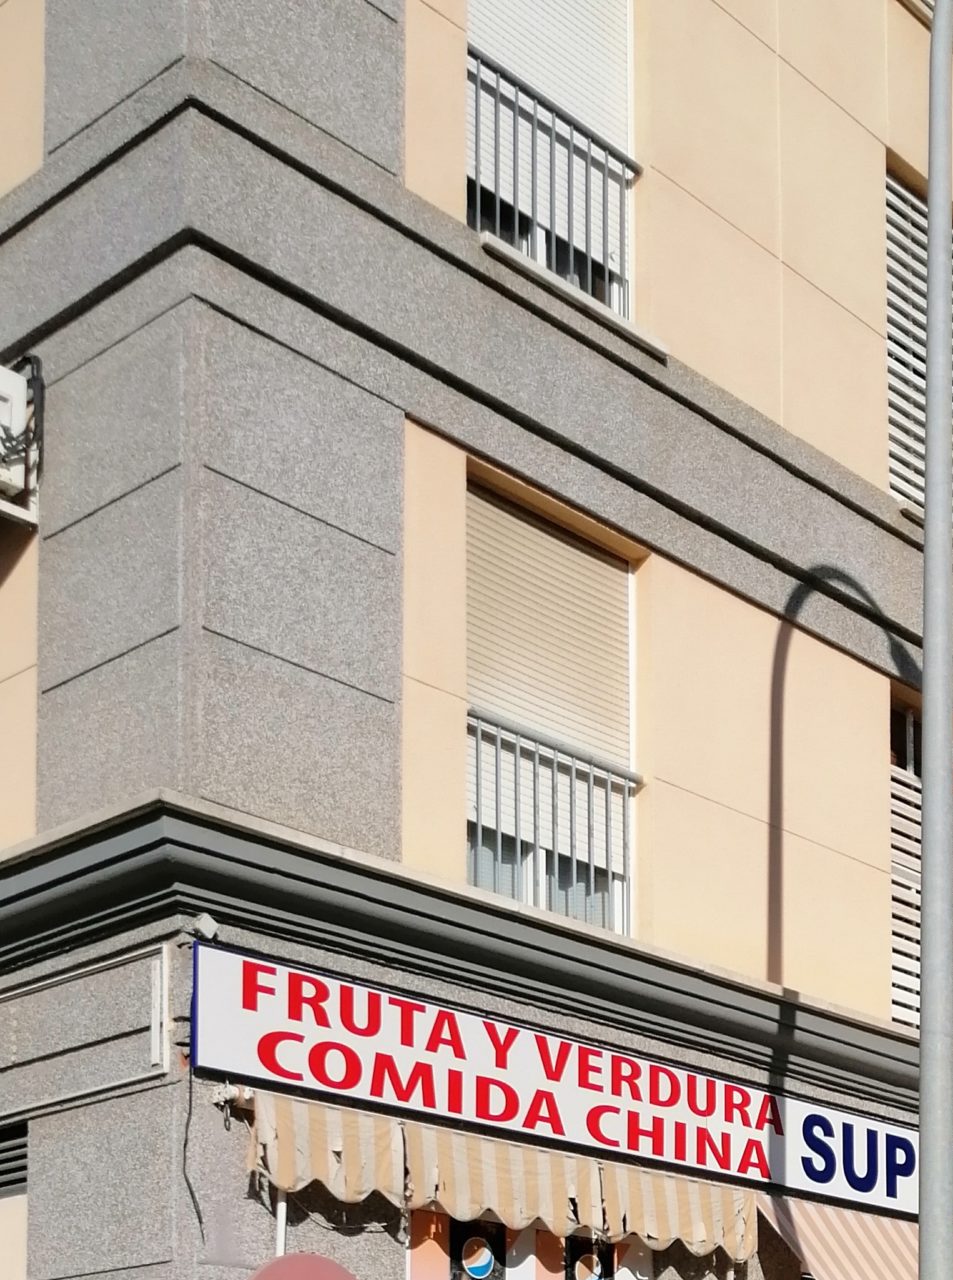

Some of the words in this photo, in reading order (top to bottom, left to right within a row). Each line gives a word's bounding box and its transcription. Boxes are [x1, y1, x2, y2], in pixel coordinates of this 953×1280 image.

[242, 960, 466, 1060] FRUTA
[483, 1021, 520, 1068] Y
[533, 1034, 784, 1135] VERDURA
[256, 1031, 565, 1136] COMIDA
[586, 1105, 771, 1179] CHINA
